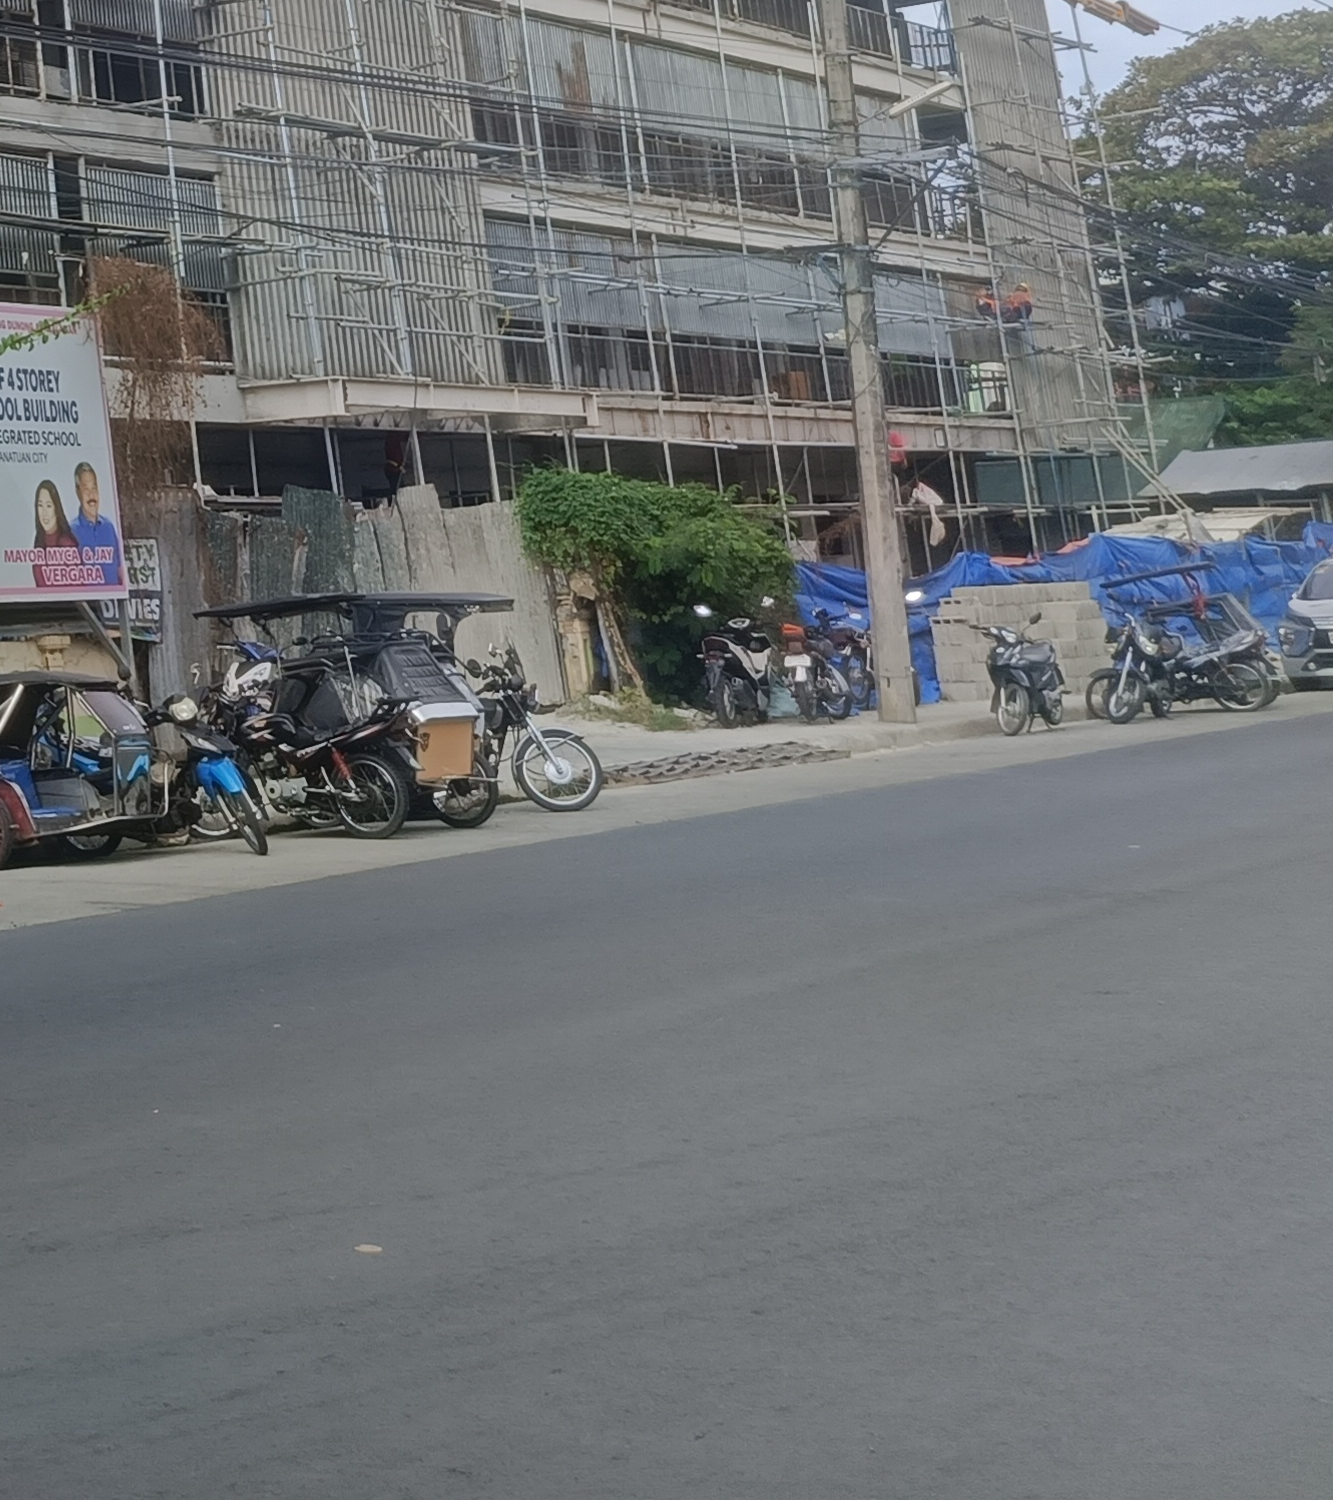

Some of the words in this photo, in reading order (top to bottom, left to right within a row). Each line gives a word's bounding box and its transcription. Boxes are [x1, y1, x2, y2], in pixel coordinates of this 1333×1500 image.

[7, 367, 15, 391] 4
[16, 368, 60, 394] STOREY
[24, 398, 79, 425] BUILDING
[41, 430, 82, 448] SCHOOL
[33, 452, 48, 464] CITY
[4, 549, 45, 564] MAYOR
[46, 547, 80, 564] MYCA
[83, 547, 93, 563] &
[94, 547, 114, 563] JAY
[42, 565, 105, 585] VERGARA
